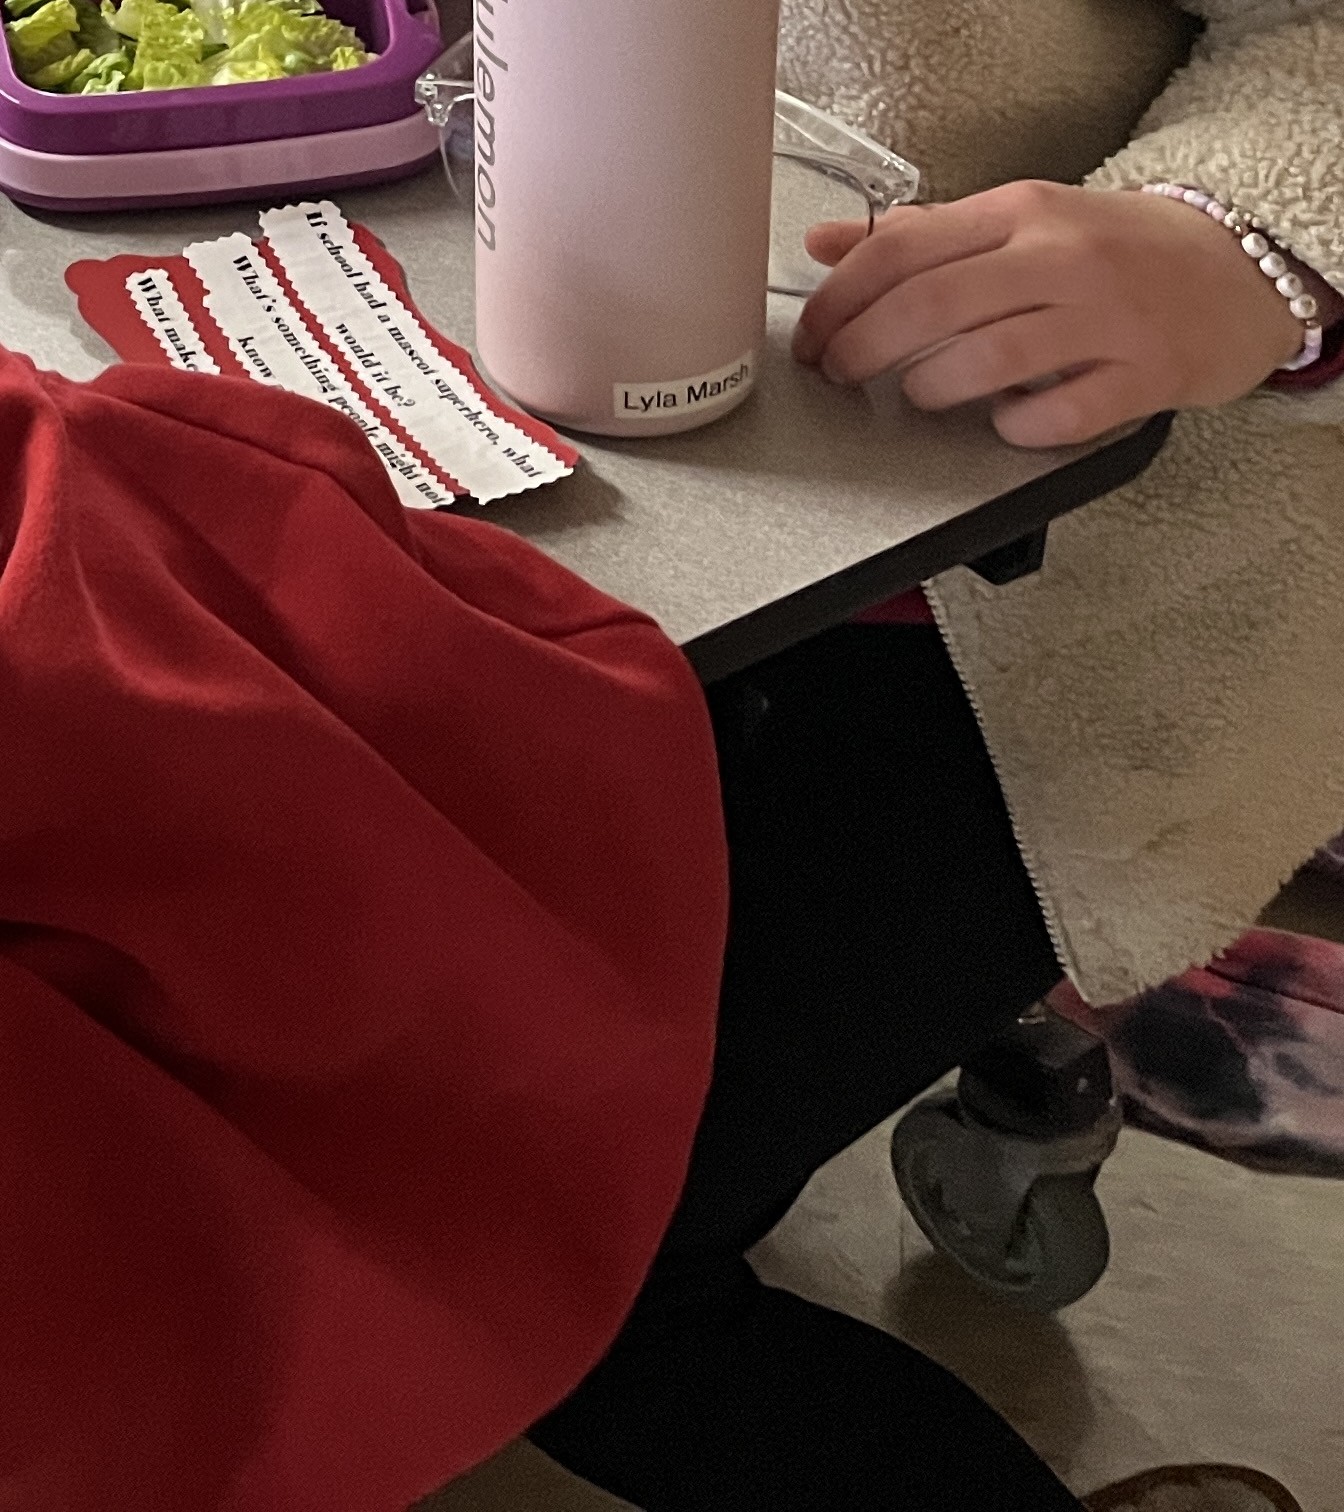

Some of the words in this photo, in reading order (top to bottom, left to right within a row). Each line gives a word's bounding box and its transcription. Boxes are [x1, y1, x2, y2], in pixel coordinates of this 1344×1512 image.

[137, 277, 171, 323] What
[237, 335, 275, 378] know
[305, 211, 328, 228] If
[317, 232, 362, 278] school
[354, 281, 387, 310] had
[377, 314, 391, 323] a
[387, 326, 437, 376] mascot
[430, 371, 500, 445] superhero,
[502, 447, 546, 478] what
[335, 323, 374, 369] would
[372, 369, 391, 384] it
[383, 384, 416, 408] be?
[232, 255, 276, 313] What's
[271, 315, 339, 394] something
[376, 442, 421, 482] might
[415, 481, 448, 504] not
[623, 390, 678, 412] Lyla
[686, 363, 749, 404] Marsh
